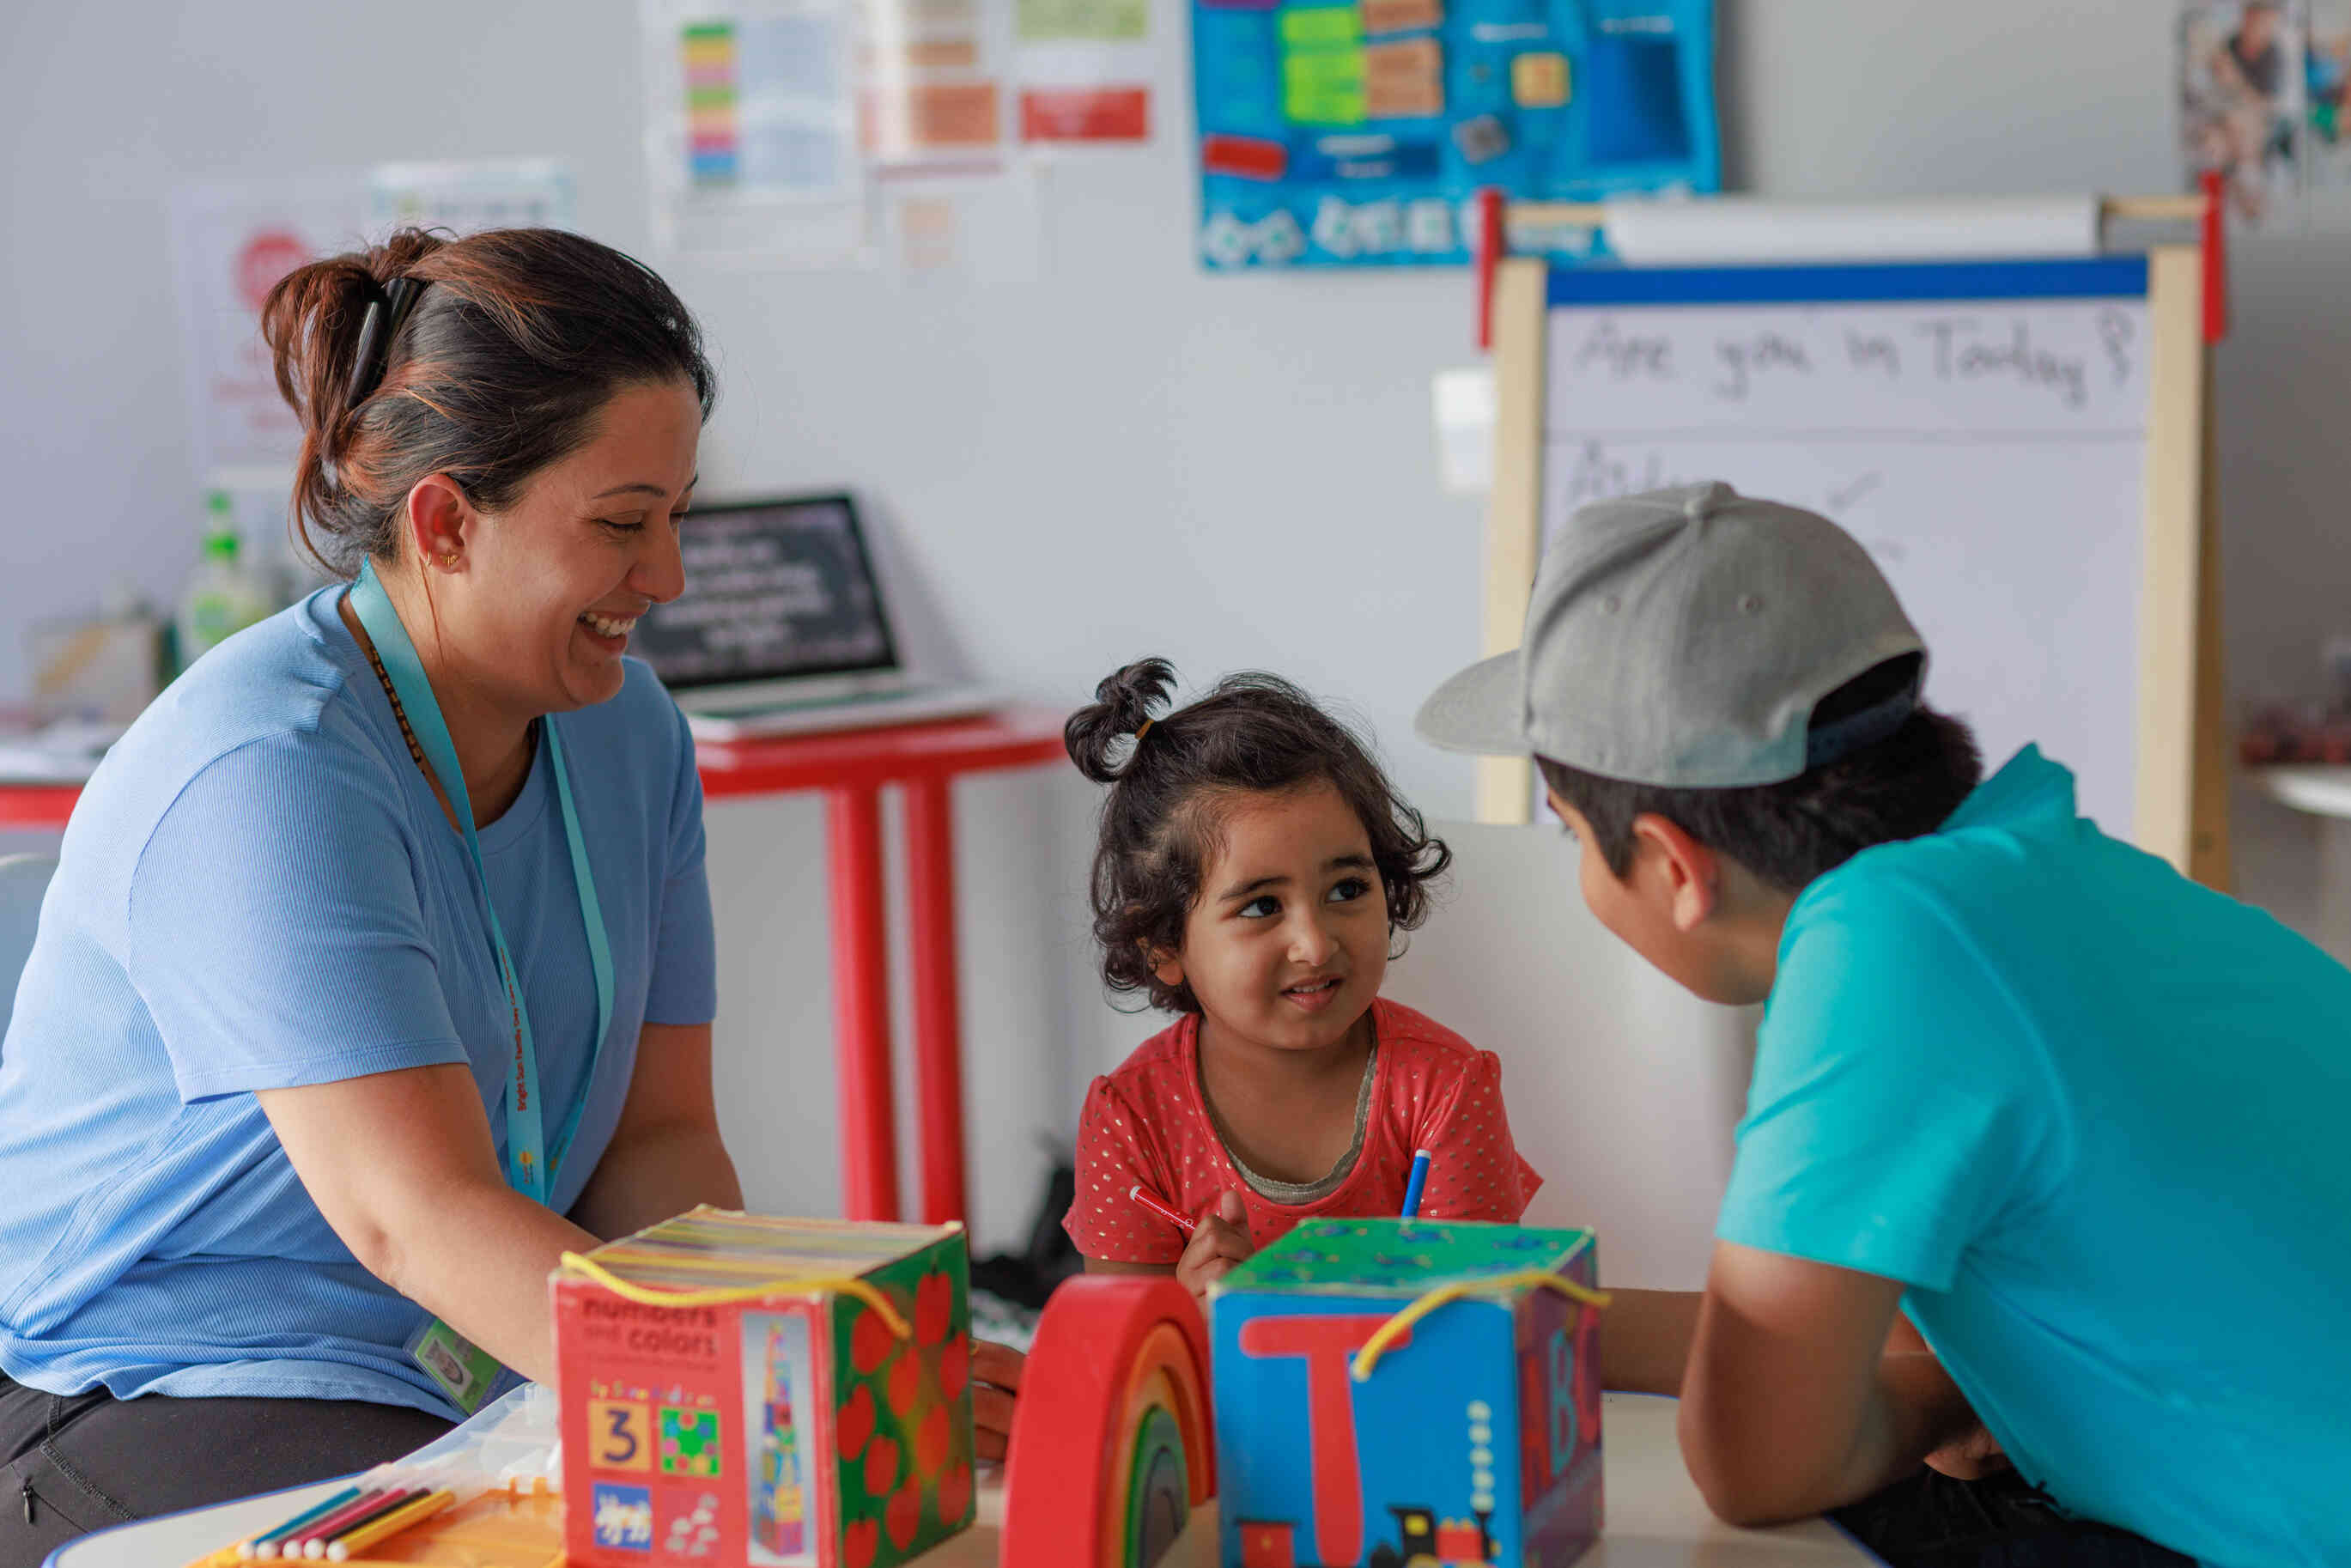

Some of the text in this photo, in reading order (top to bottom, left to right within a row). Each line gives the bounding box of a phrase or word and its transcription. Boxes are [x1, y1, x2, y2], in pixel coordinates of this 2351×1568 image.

[1573, 314, 1674, 380] Are
[1712, 331, 1813, 404] you
[1845, 323, 1902, 378] in
[515, 1061, 525, 1081] Sun
[516, 1081, 527, 1112] Bright
[584, 1299, 716, 1328] numbers
[629, 1328, 716, 1356] colors
[602, 1409, 638, 1463] 3
[1240, 1316, 1414, 1568] T
